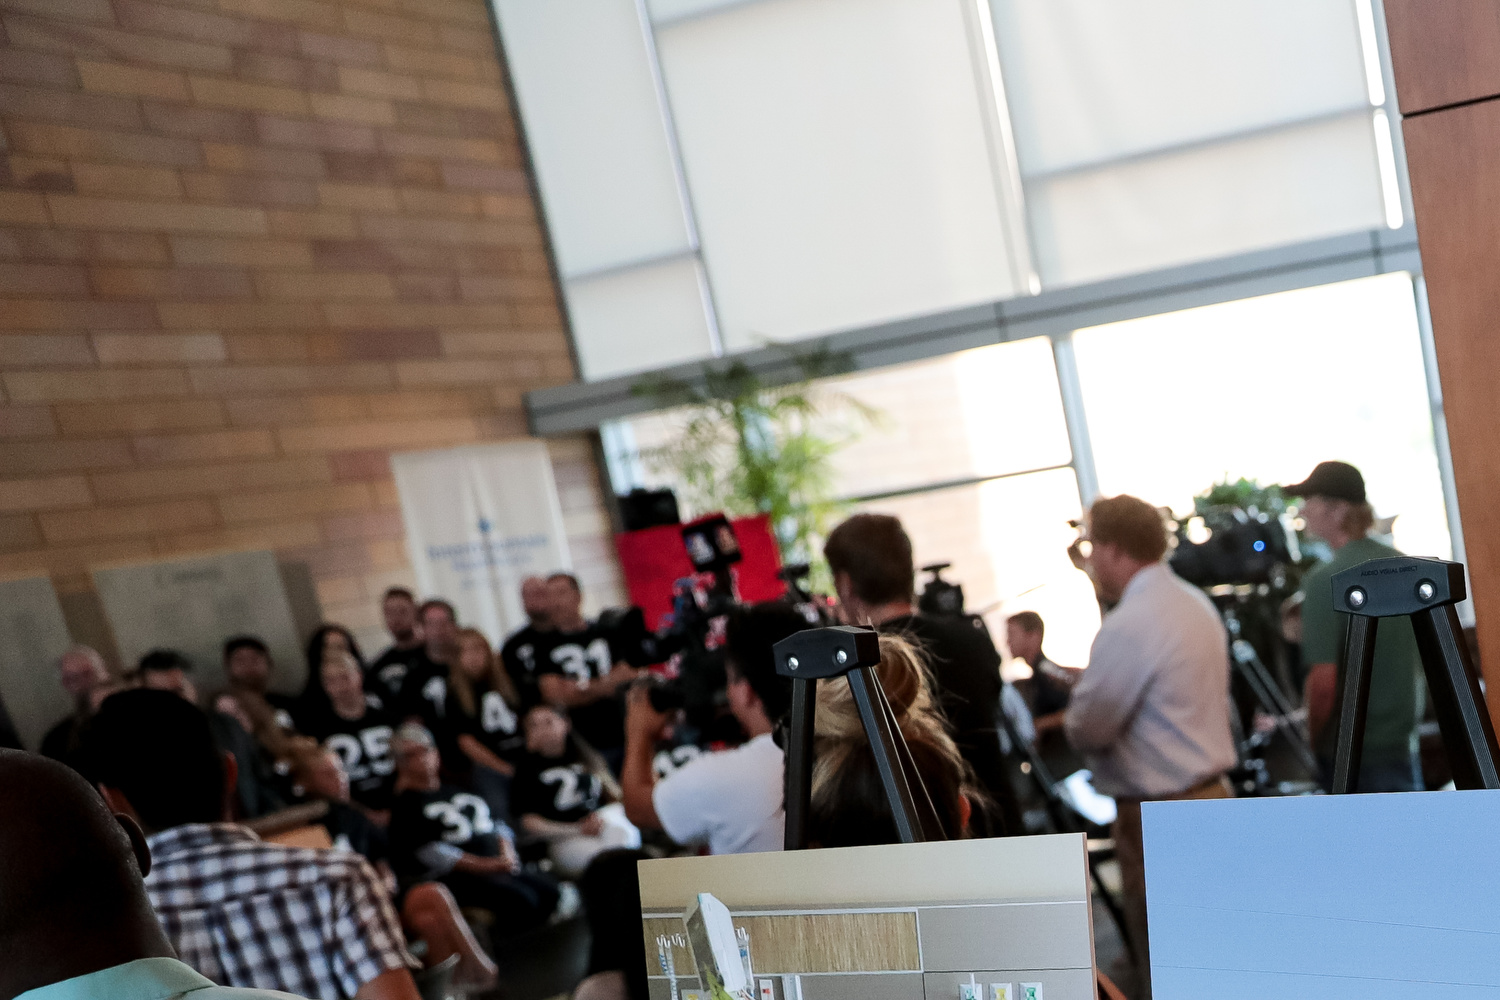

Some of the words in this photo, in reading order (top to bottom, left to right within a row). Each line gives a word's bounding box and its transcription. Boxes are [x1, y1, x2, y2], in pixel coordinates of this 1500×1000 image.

[1360, 569, 1379, 577] AUDIO
[1380, 567, 1399, 576] VISUAL
[1399, 565, 1418, 573] DIRECT
